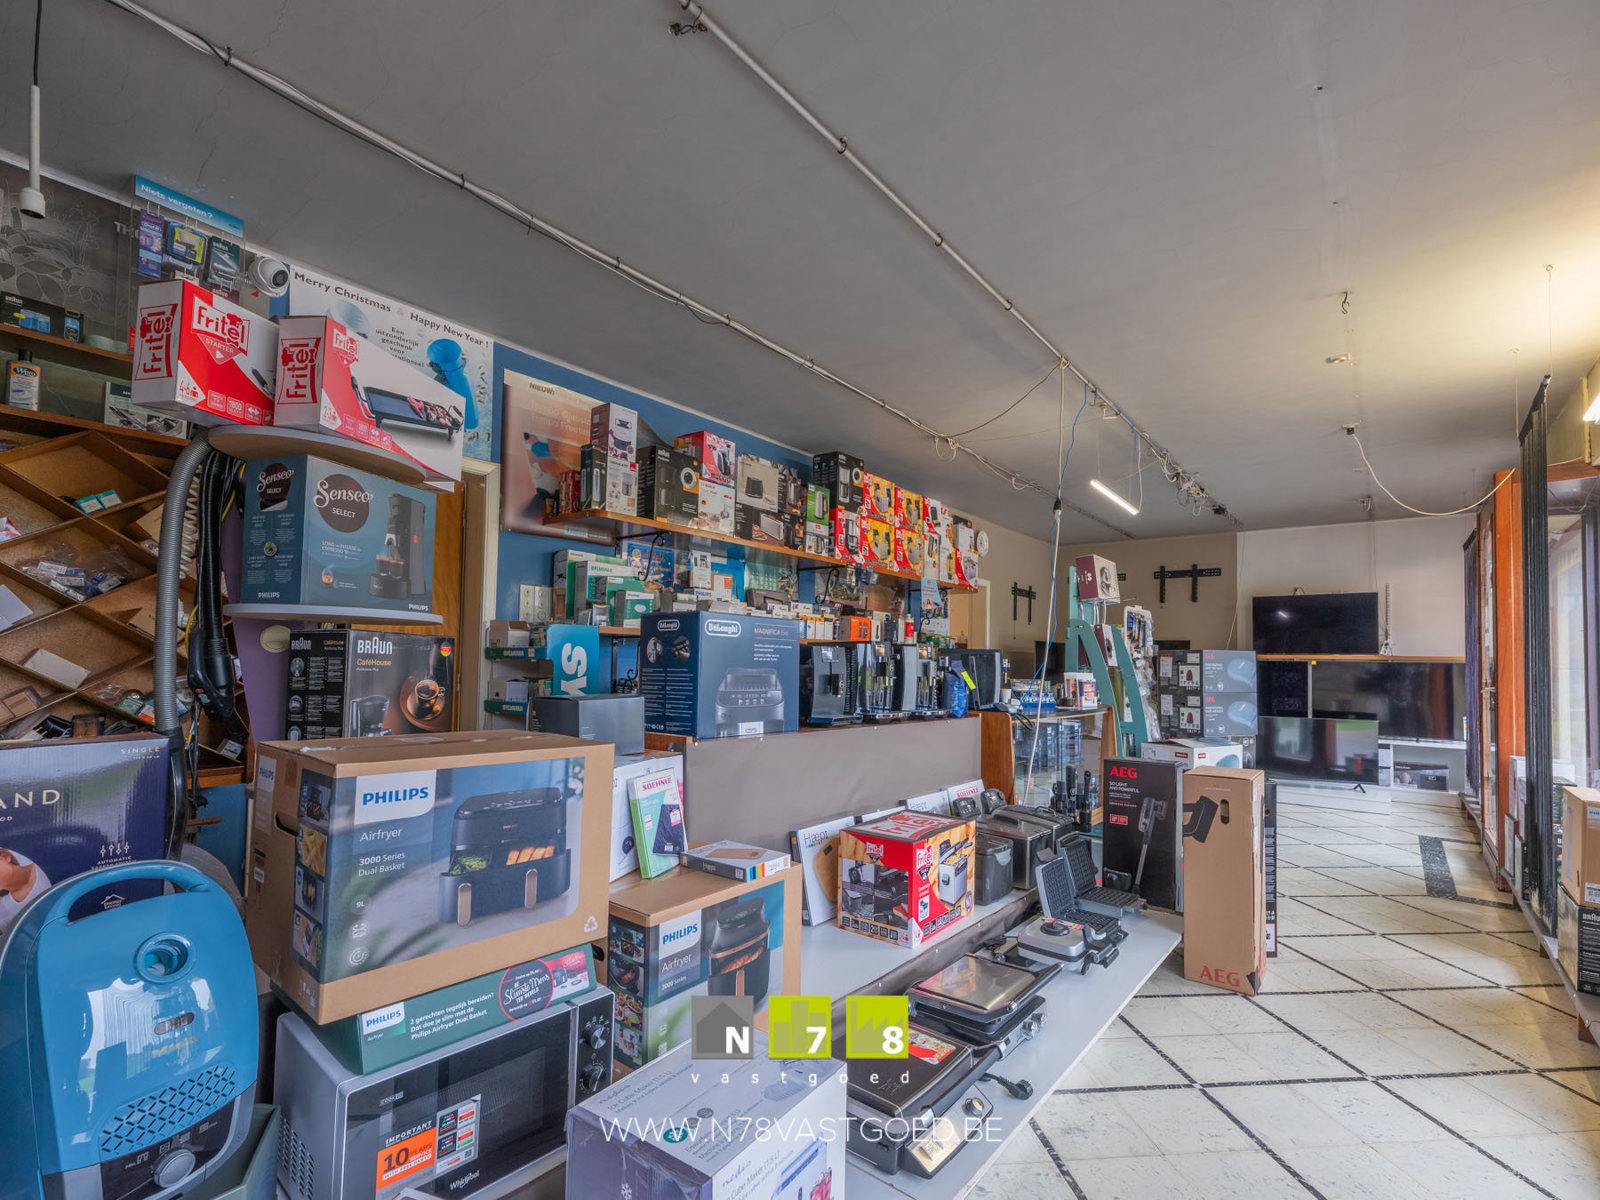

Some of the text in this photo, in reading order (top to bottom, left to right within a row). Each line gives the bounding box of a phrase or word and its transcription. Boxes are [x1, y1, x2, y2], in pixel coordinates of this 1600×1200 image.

[141, 184, 166, 200] Niets
[294, 271, 391, 312] Merry Christmas
[197, 306, 245, 343] Fritel
[391, 327, 405, 336] Een
[410, 312, 441, 331] Happy
[444, 325, 463, 339] New
[464, 332, 483, 346] Year
[143, 311, 166, 373] Fritel
[205, 339, 234, 354] STARTER
[375, 329, 419, 347] uitzonderlijk
[381, 338, 413, 351] geschenk
[286, 343, 310, 398] Fritel
[257, 470, 295, 493] Senseo
[313, 479, 374, 509] Senseo
[331, 507, 356, 519] SELECT
[408, 603, 429, 612] PHILIPS
[291, 637, 311, 650] BRAUN
[357, 636, 393, 655] BRAUN
[120, 746, 160, 754] SINGLE
[1109, 765, 1137, 779] AEG
[642, 778, 672, 791] SOEHNLE
[362, 787, 429, 805] PHILIPS
[359, 827, 403, 844] Airfryer
[97, 856, 132, 865] AUTOMATIC
[359, 851, 405, 866] 3000 Series
[358, 862, 405, 877] Dual Basket
[662, 923, 698, 944] PHILIPS
[661, 953, 692, 973] Airfryer
[1200, 965, 1241, 987] AEG
[415, 1010, 445, 1024] gerechten
[445, 1001, 467, 1014] tegelijk
[467, 992, 494, 1006] bereiden?
[366, 1010, 402, 1028] PHILIPS
[410, 1025, 422, 1033] Dat
[422, 1021, 435, 1029] doe
[441, 1013, 454, 1022] slim
[455, 1010, 465, 1018] met
[411, 1009, 487, 1040] Philips Airfryer Dual Basket
[386, 1120, 432, 1145] IMPORTANT
[383, 1147, 409, 1173] 10
[410, 1148, 432, 1161] SERVICE
[449, 1170, 480, 1190] Whirlpool
